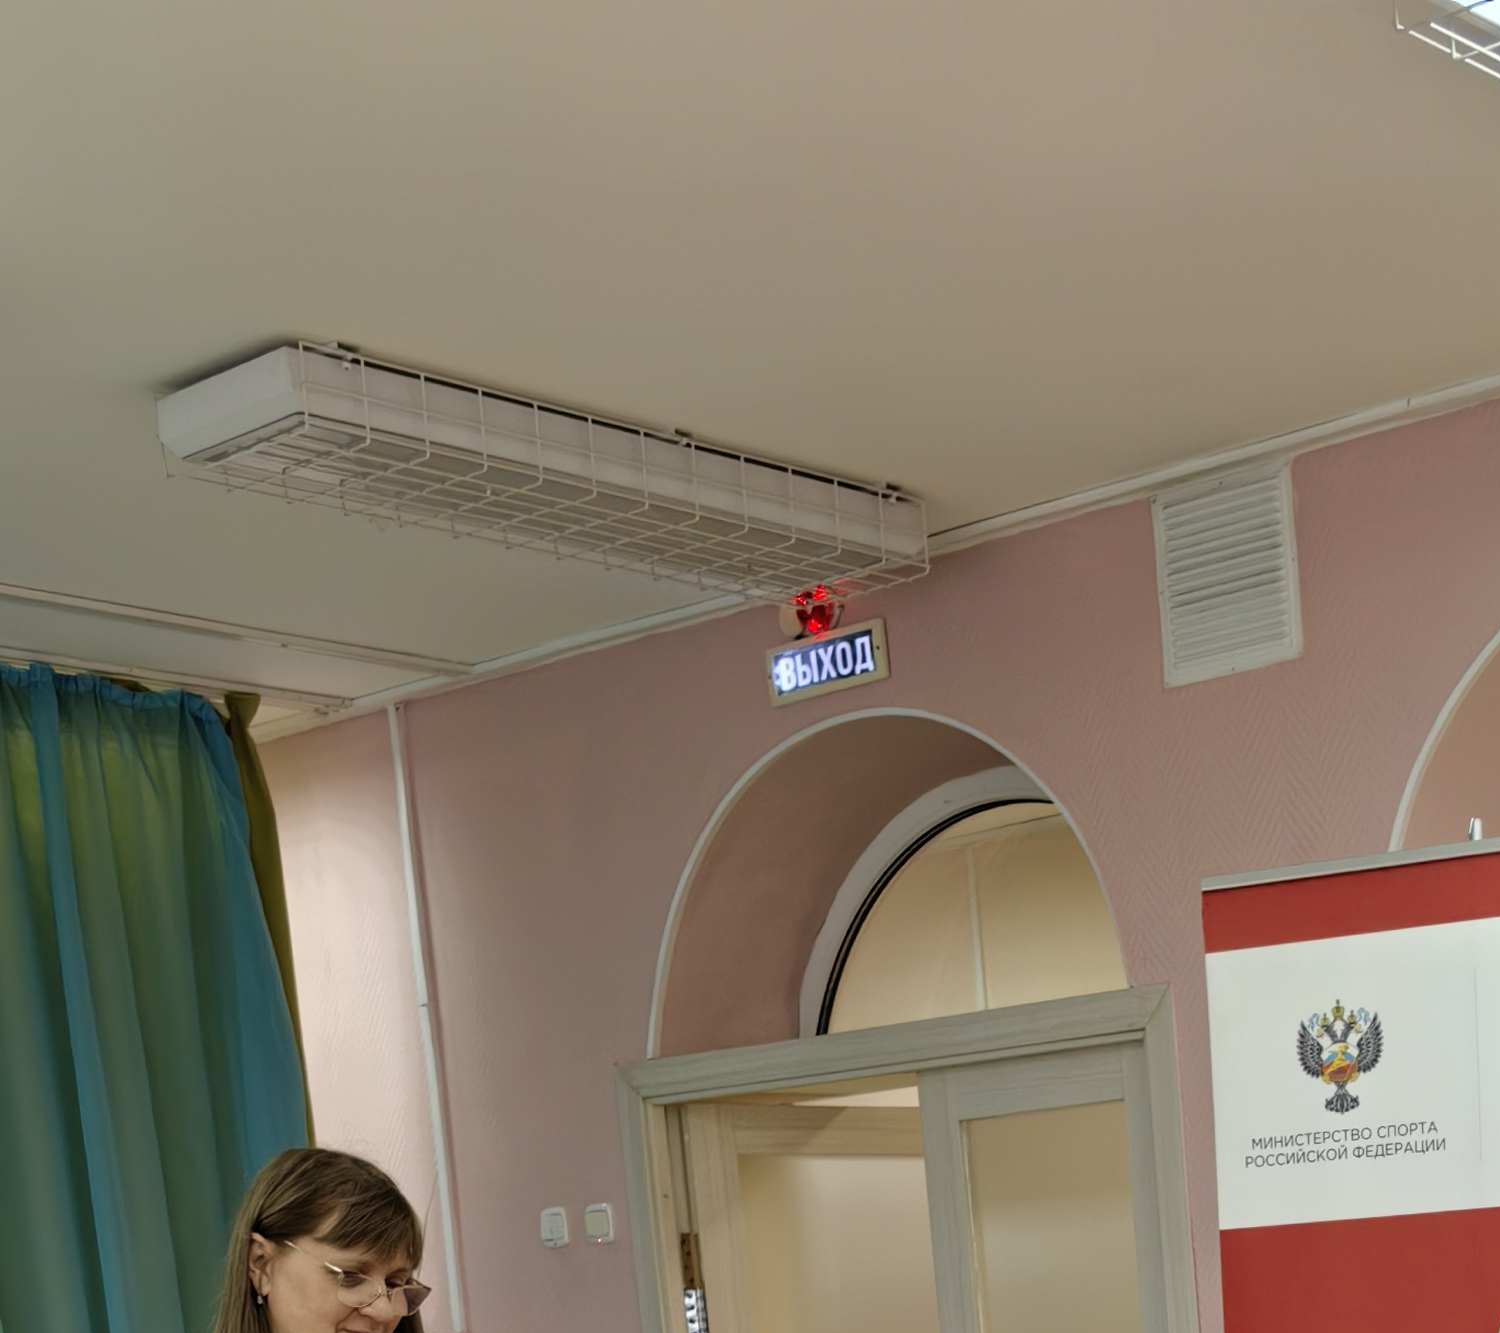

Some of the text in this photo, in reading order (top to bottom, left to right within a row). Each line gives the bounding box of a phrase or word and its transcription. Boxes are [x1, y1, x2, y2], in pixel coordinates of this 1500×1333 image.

[779, 635, 875, 692] ВЫХОД
[1251, 1121, 1439, 1150] МИНИСТЕРСТВО СПОРТА
[1244, 1137, 1446, 1168] РОССИЙСКОЙ ФЕДЕРАЦИИ
